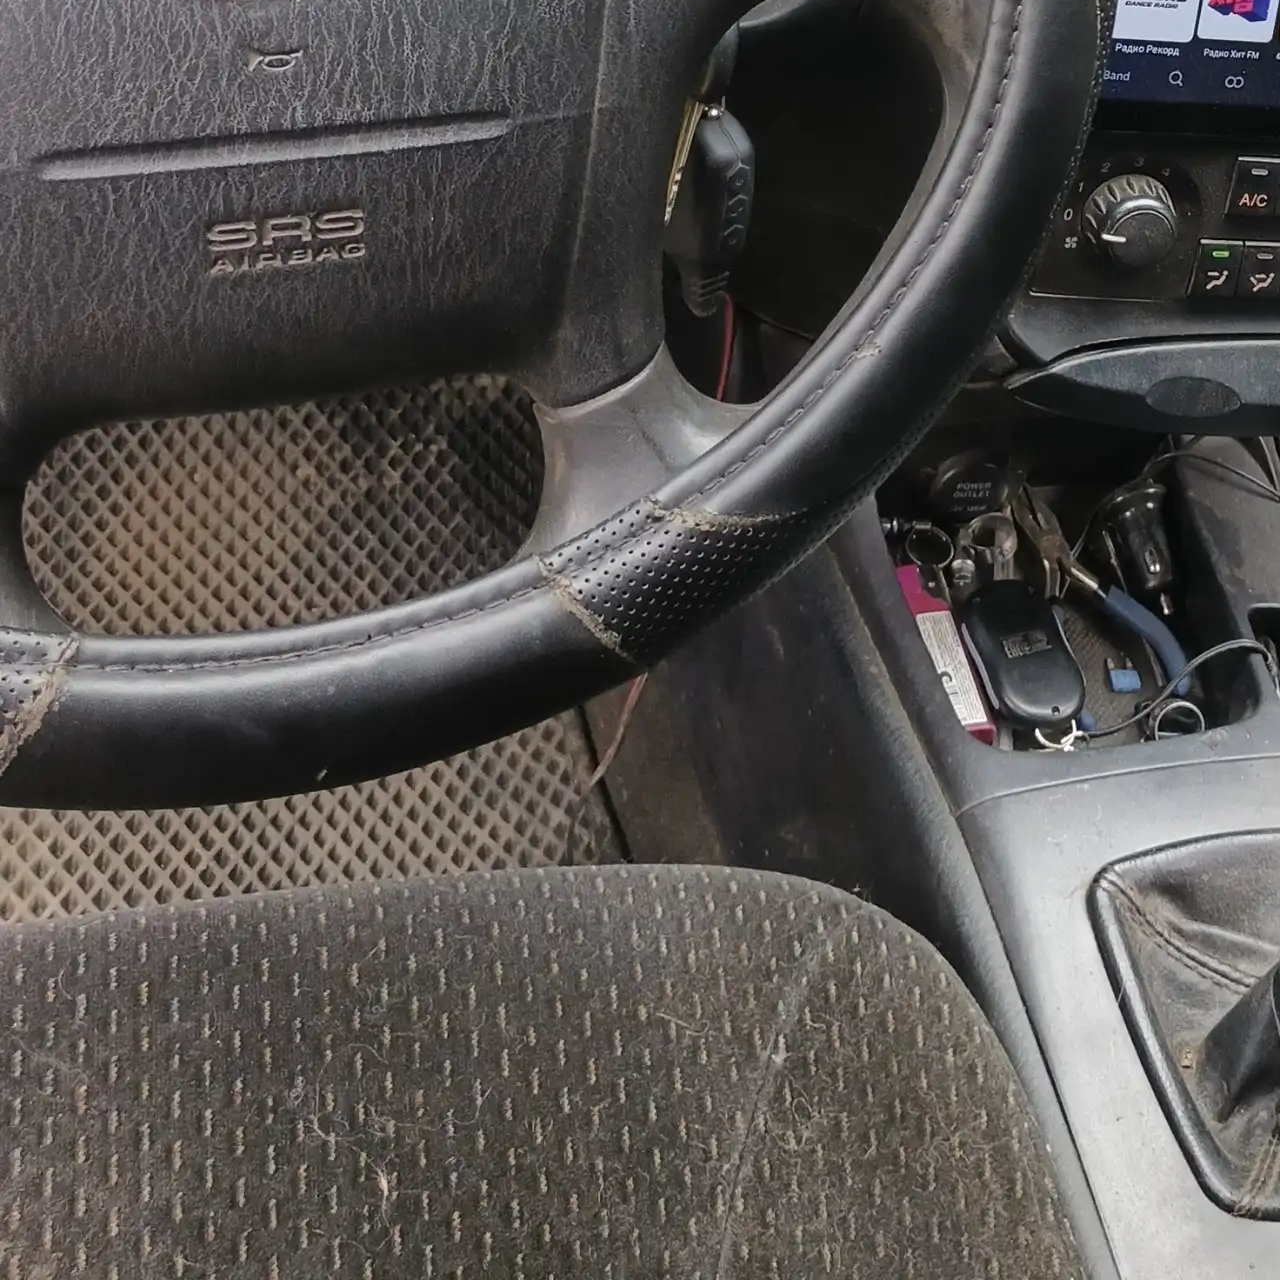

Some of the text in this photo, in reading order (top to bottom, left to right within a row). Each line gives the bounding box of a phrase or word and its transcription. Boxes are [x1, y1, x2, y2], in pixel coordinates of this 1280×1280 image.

[1115, 43, 1180, 57] Радио Рекорд
[1203, 48, 1230, 59] Радио
[1246, 51, 1260, 60] FM
[1103, 70, 1131, 81] Band
[1101, 162, 1111, 173] 2
[1134, 156, 1145, 168] 3
[1239, 192, 1268, 208] A/C
[206, 208, 365, 253] SRS
[209, 242, 366, 277] AIRBAG
[956, 482, 992, 490] POWER
[952, 490, 991, 498] OUTLET
